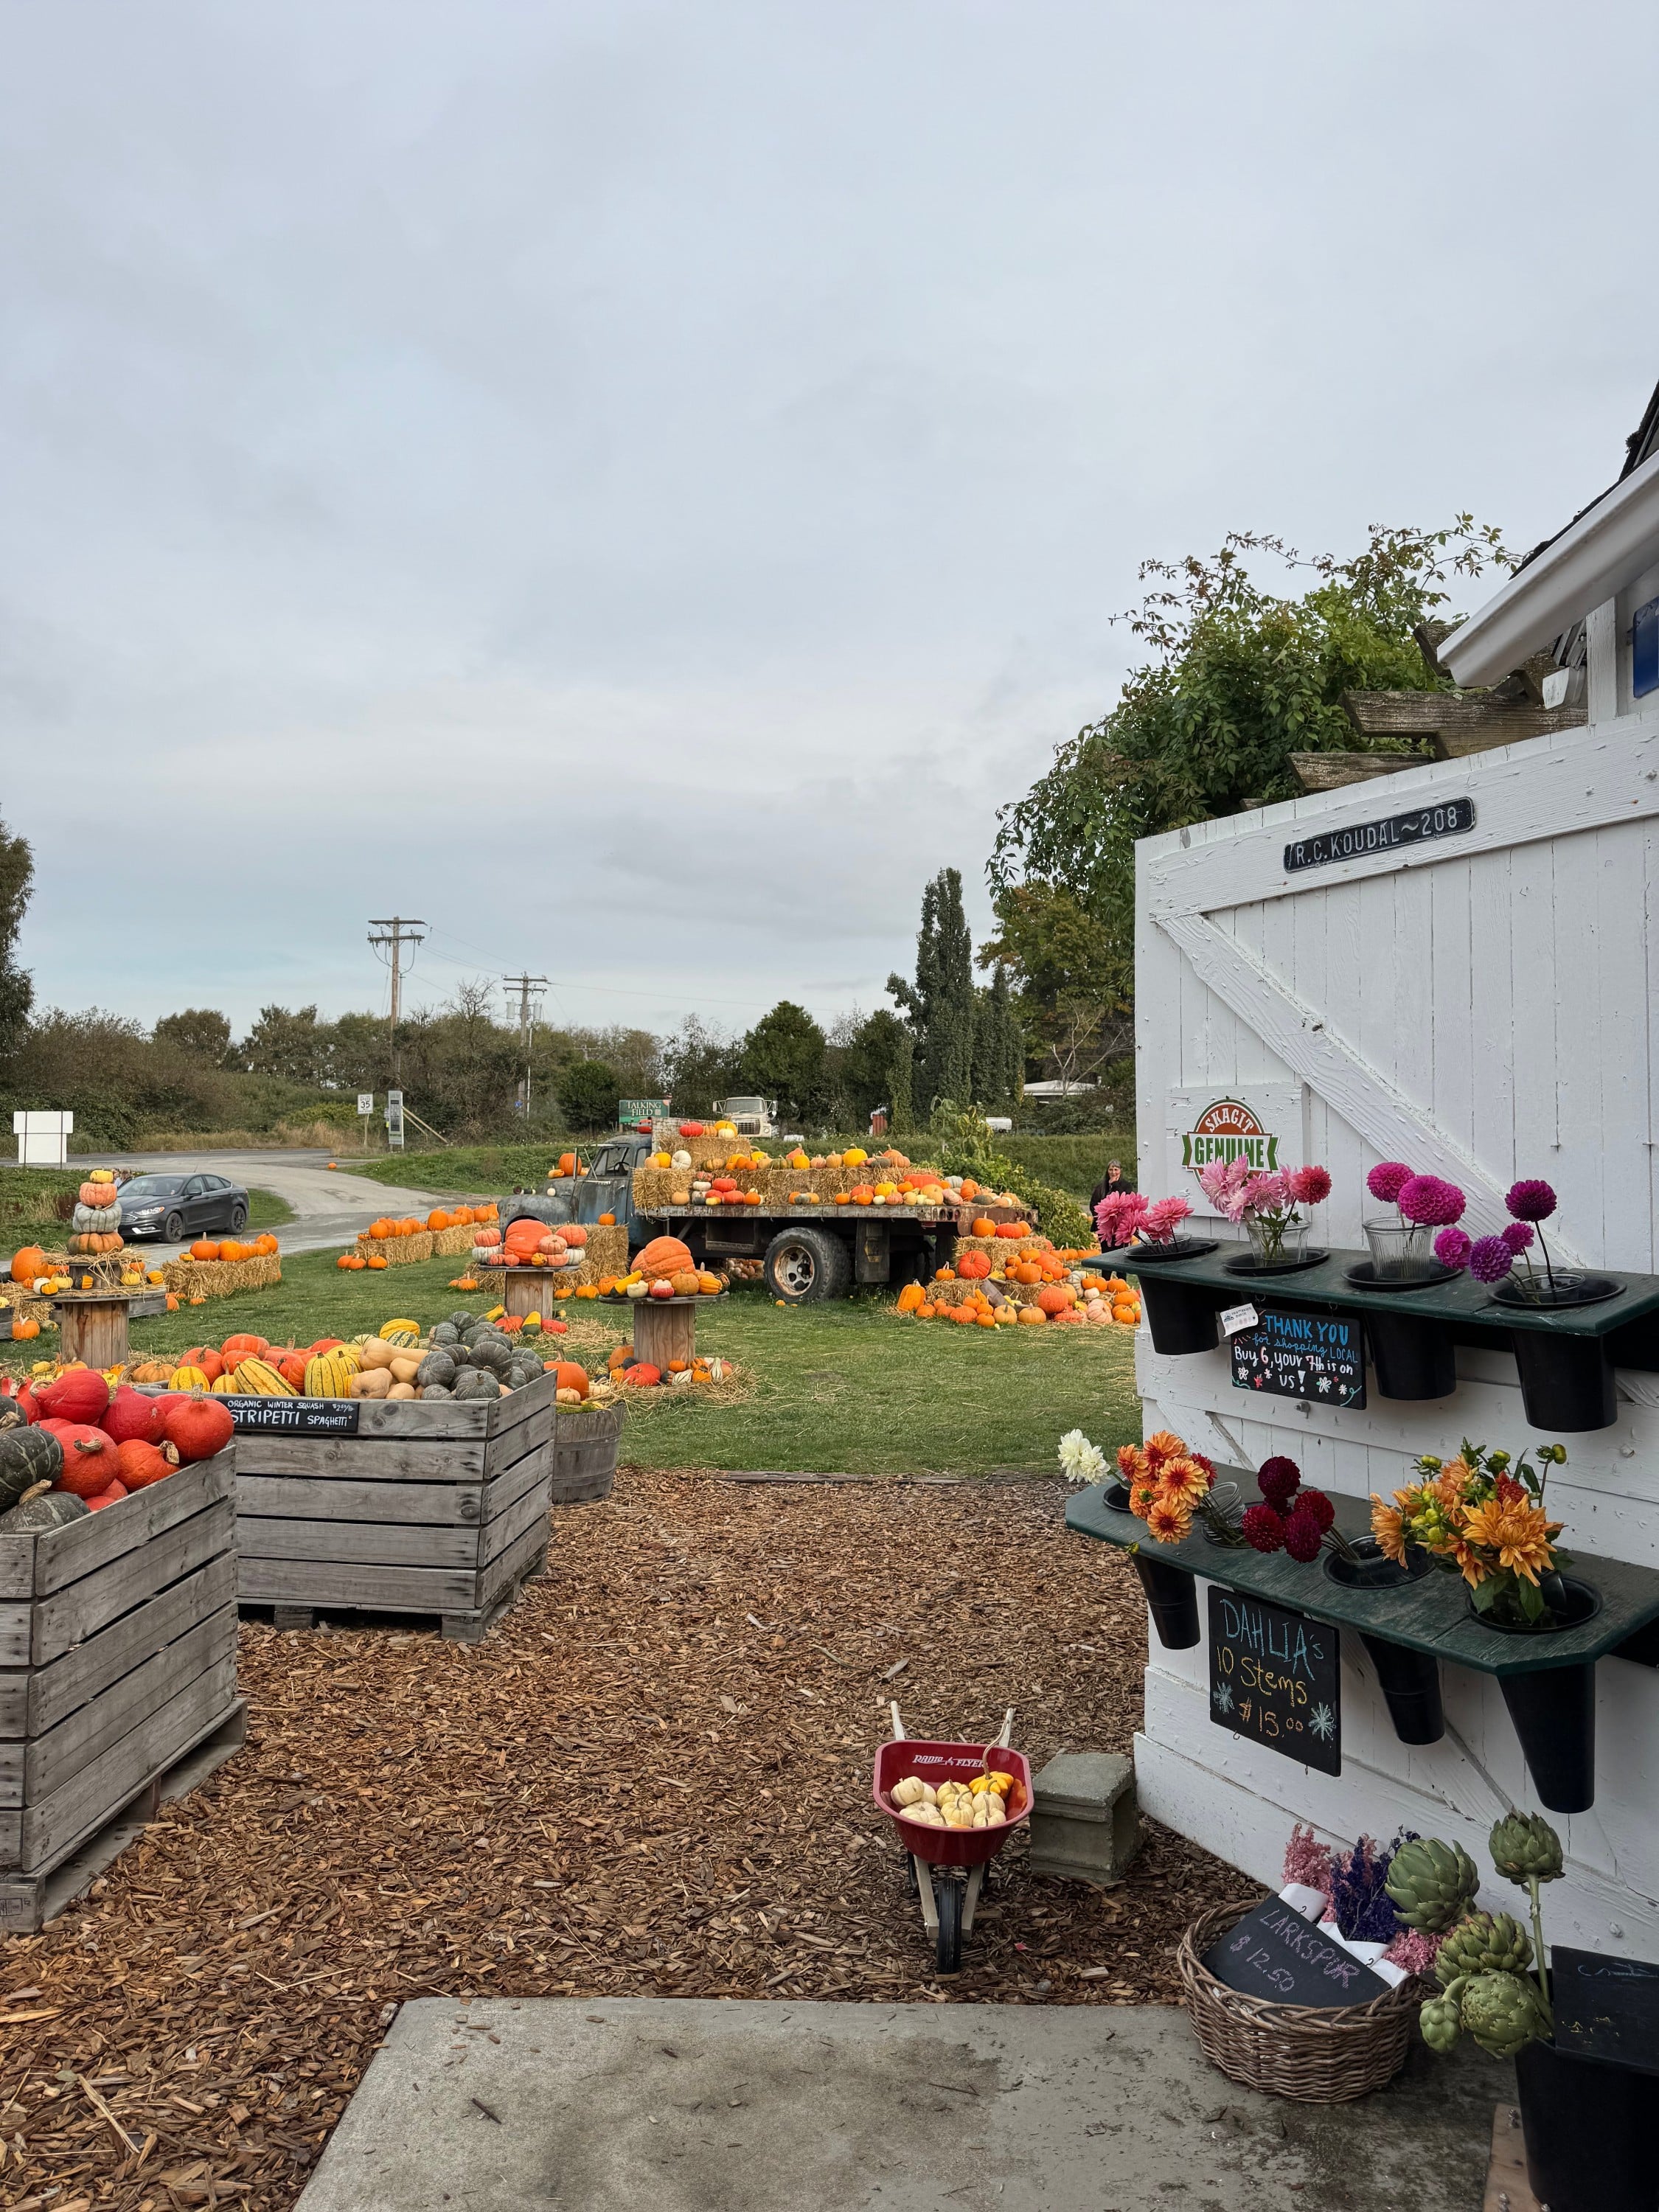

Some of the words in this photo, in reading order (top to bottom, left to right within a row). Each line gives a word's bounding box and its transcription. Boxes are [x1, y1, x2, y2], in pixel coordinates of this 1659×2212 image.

[627, 1101, 661, 1109] TALKING
[1205, 1107, 1254, 1133] SKAGIT
[1194, 1136, 1265, 1168] GENUINE
[1265, 1315, 1313, 1339] THANK
[1316, 1321, 1349, 1346] YOU
[1234, 1346, 1259, 1367] Buy
[1274, 1352, 1303, 1371] your
[1305, 1355, 1325, 1372] 7th
[1327, 1360, 1337, 1371] is
[1340, 1364, 1353, 1376] on
[1252, 1332, 1271, 1346] for
[1273, 1338, 1328, 1357] shopping
[1329, 1346, 1358, 1363] LOCAL
[227, 1400, 262, 1408] ORGANIC
[268, 1401, 293, 1409] WINTER
[296, 1402, 324, 1410] SQUASH
[230, 1410, 300, 1425] STRIPETTI
[307, 1415, 347, 1427] SPAGHETTI
[1217, 1646, 1234, 1675] 10
[1240, 1657, 1307, 1707] Stems
[912, 1755, 944, 1764] RADIO
[1259, 1909, 1360, 1989] LARKSPUR
